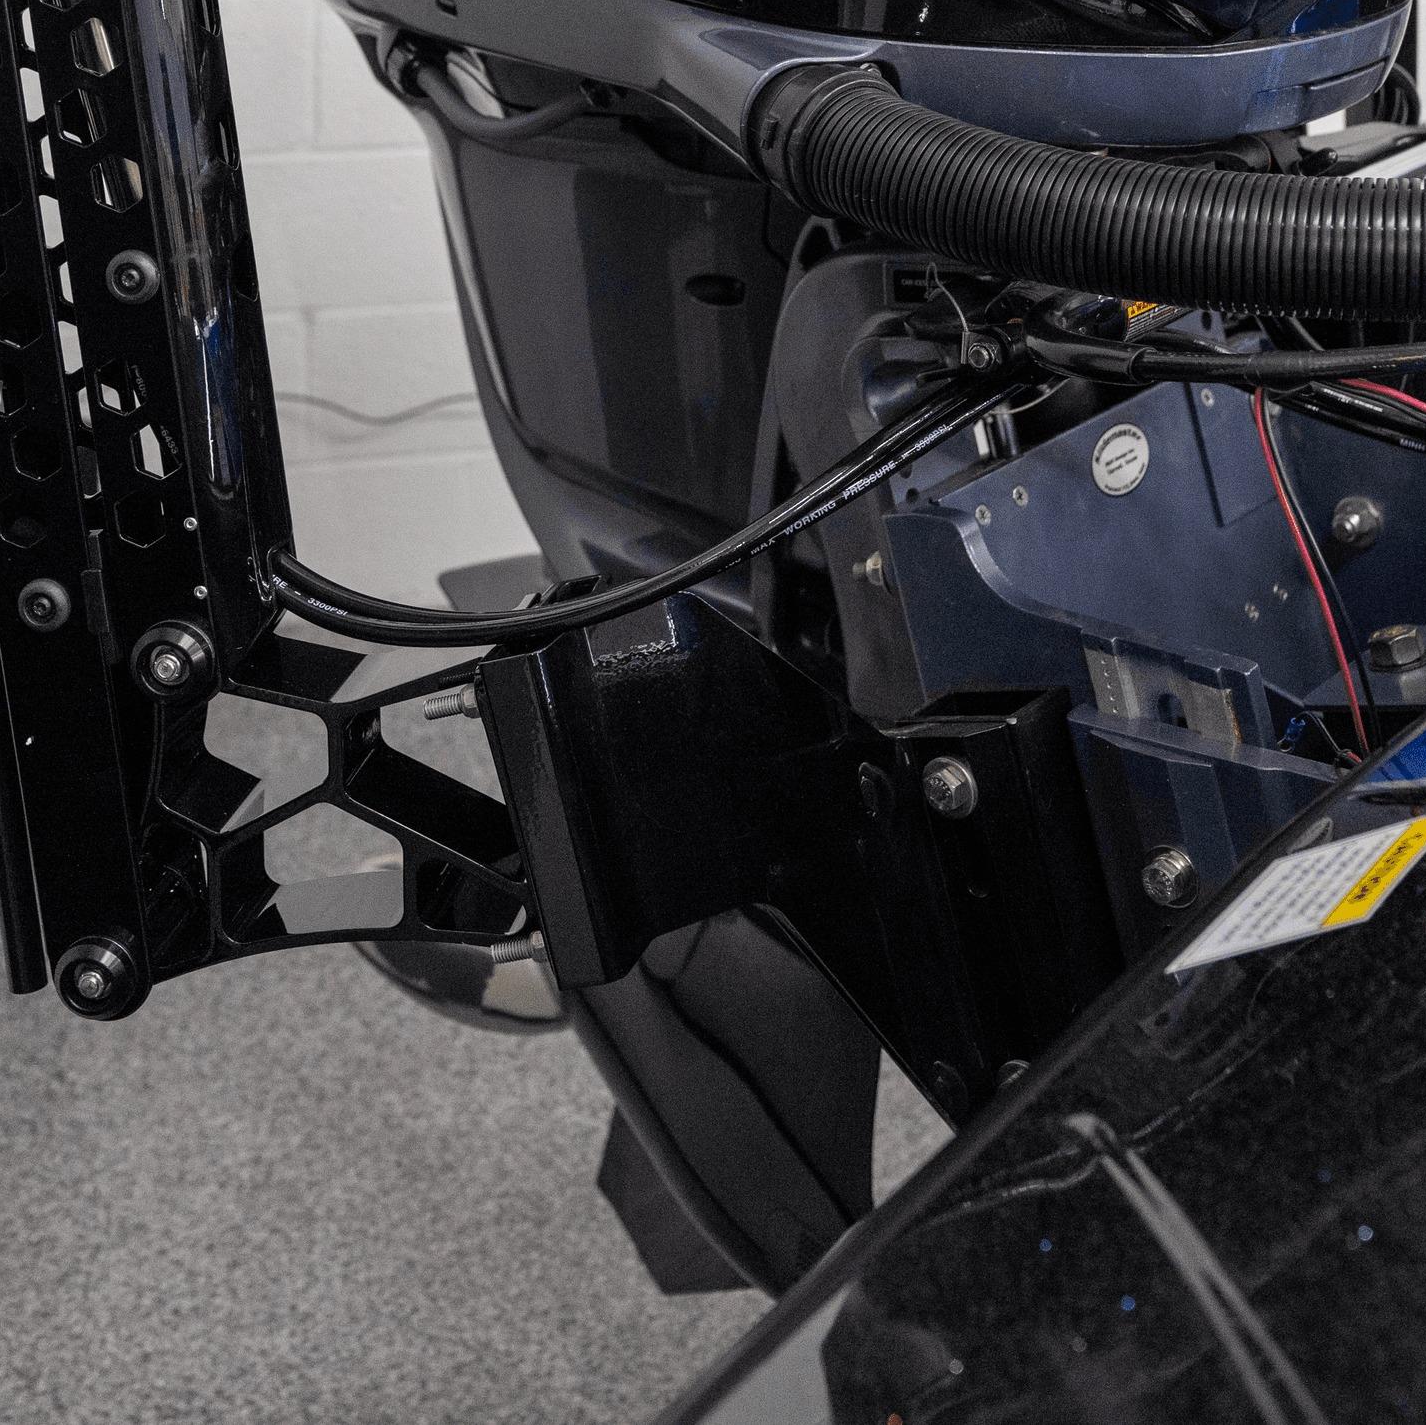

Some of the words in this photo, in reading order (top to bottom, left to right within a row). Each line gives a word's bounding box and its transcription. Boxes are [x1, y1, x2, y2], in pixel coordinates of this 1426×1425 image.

[783, 500, 837, 536] WORKING
[842, 460, 897, 500] PRESSURE
[307, 596, 349, 616] 3300PSI
